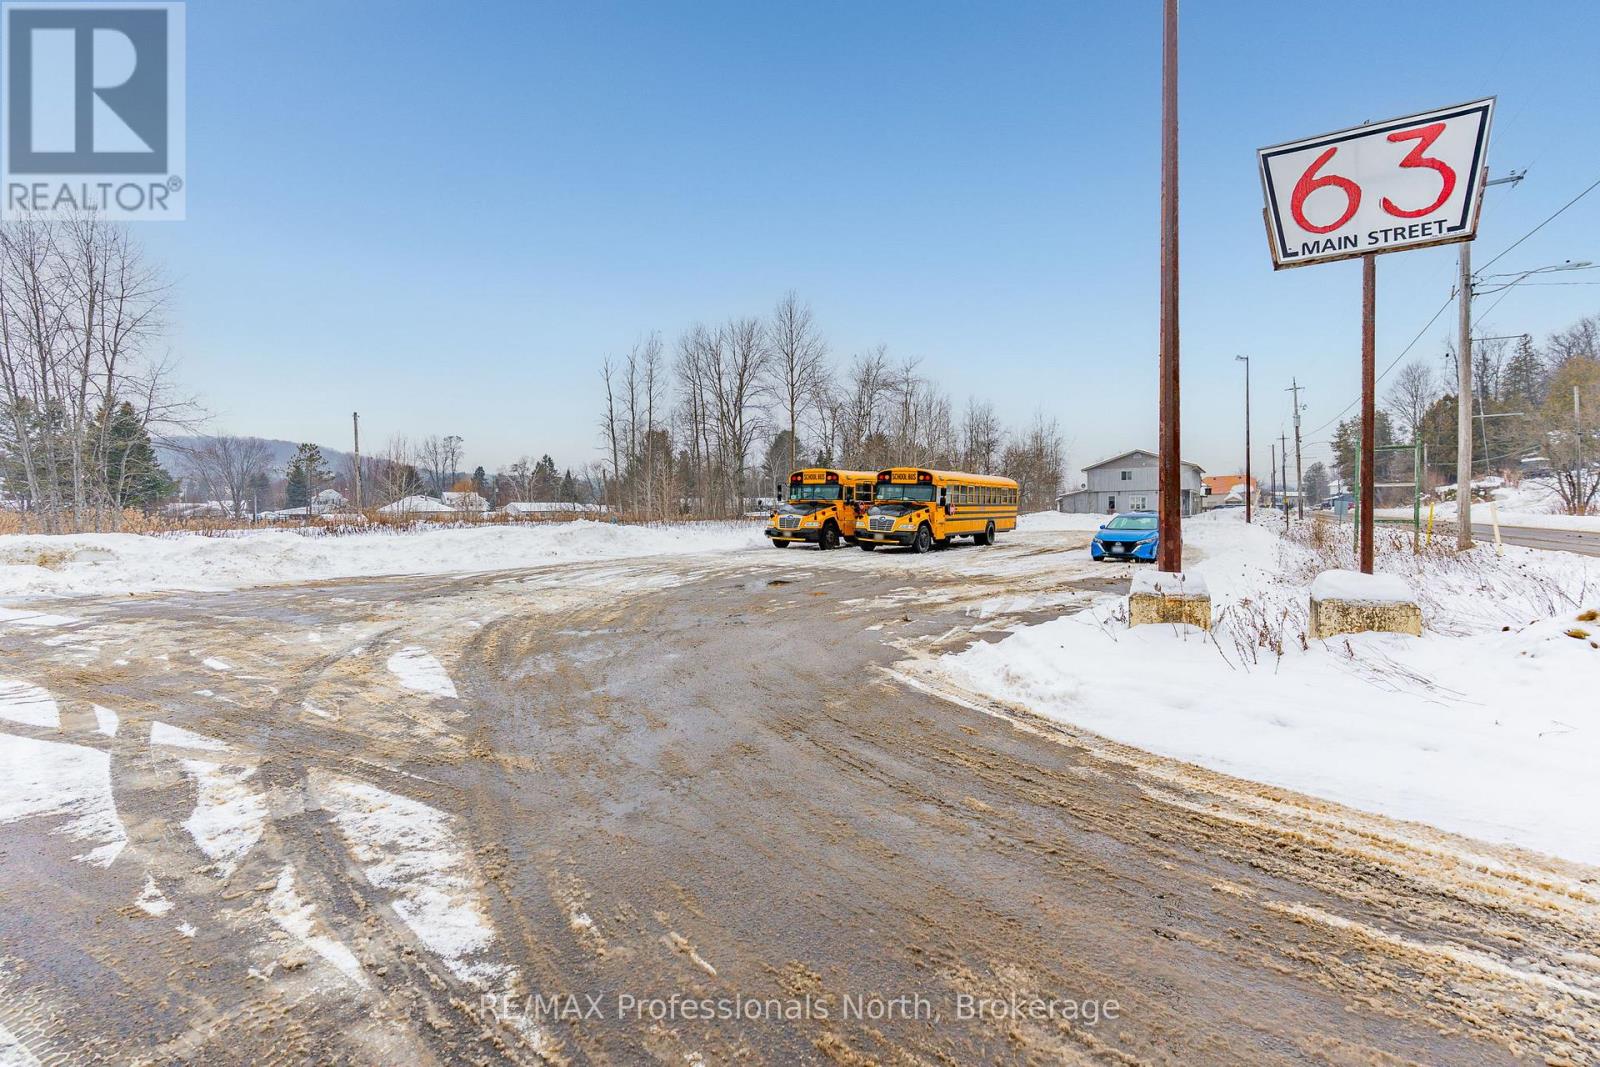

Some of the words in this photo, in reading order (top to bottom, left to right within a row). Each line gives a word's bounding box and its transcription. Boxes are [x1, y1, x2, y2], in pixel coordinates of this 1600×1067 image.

[1290, 122, 1457, 235] 63
[1301, 234, 1358, 256] MAIN
[1368, 220, 1448, 245] STREET
[892, 472, 907, 480] SCHOOL
[908, 472, 916, 480] BUS
